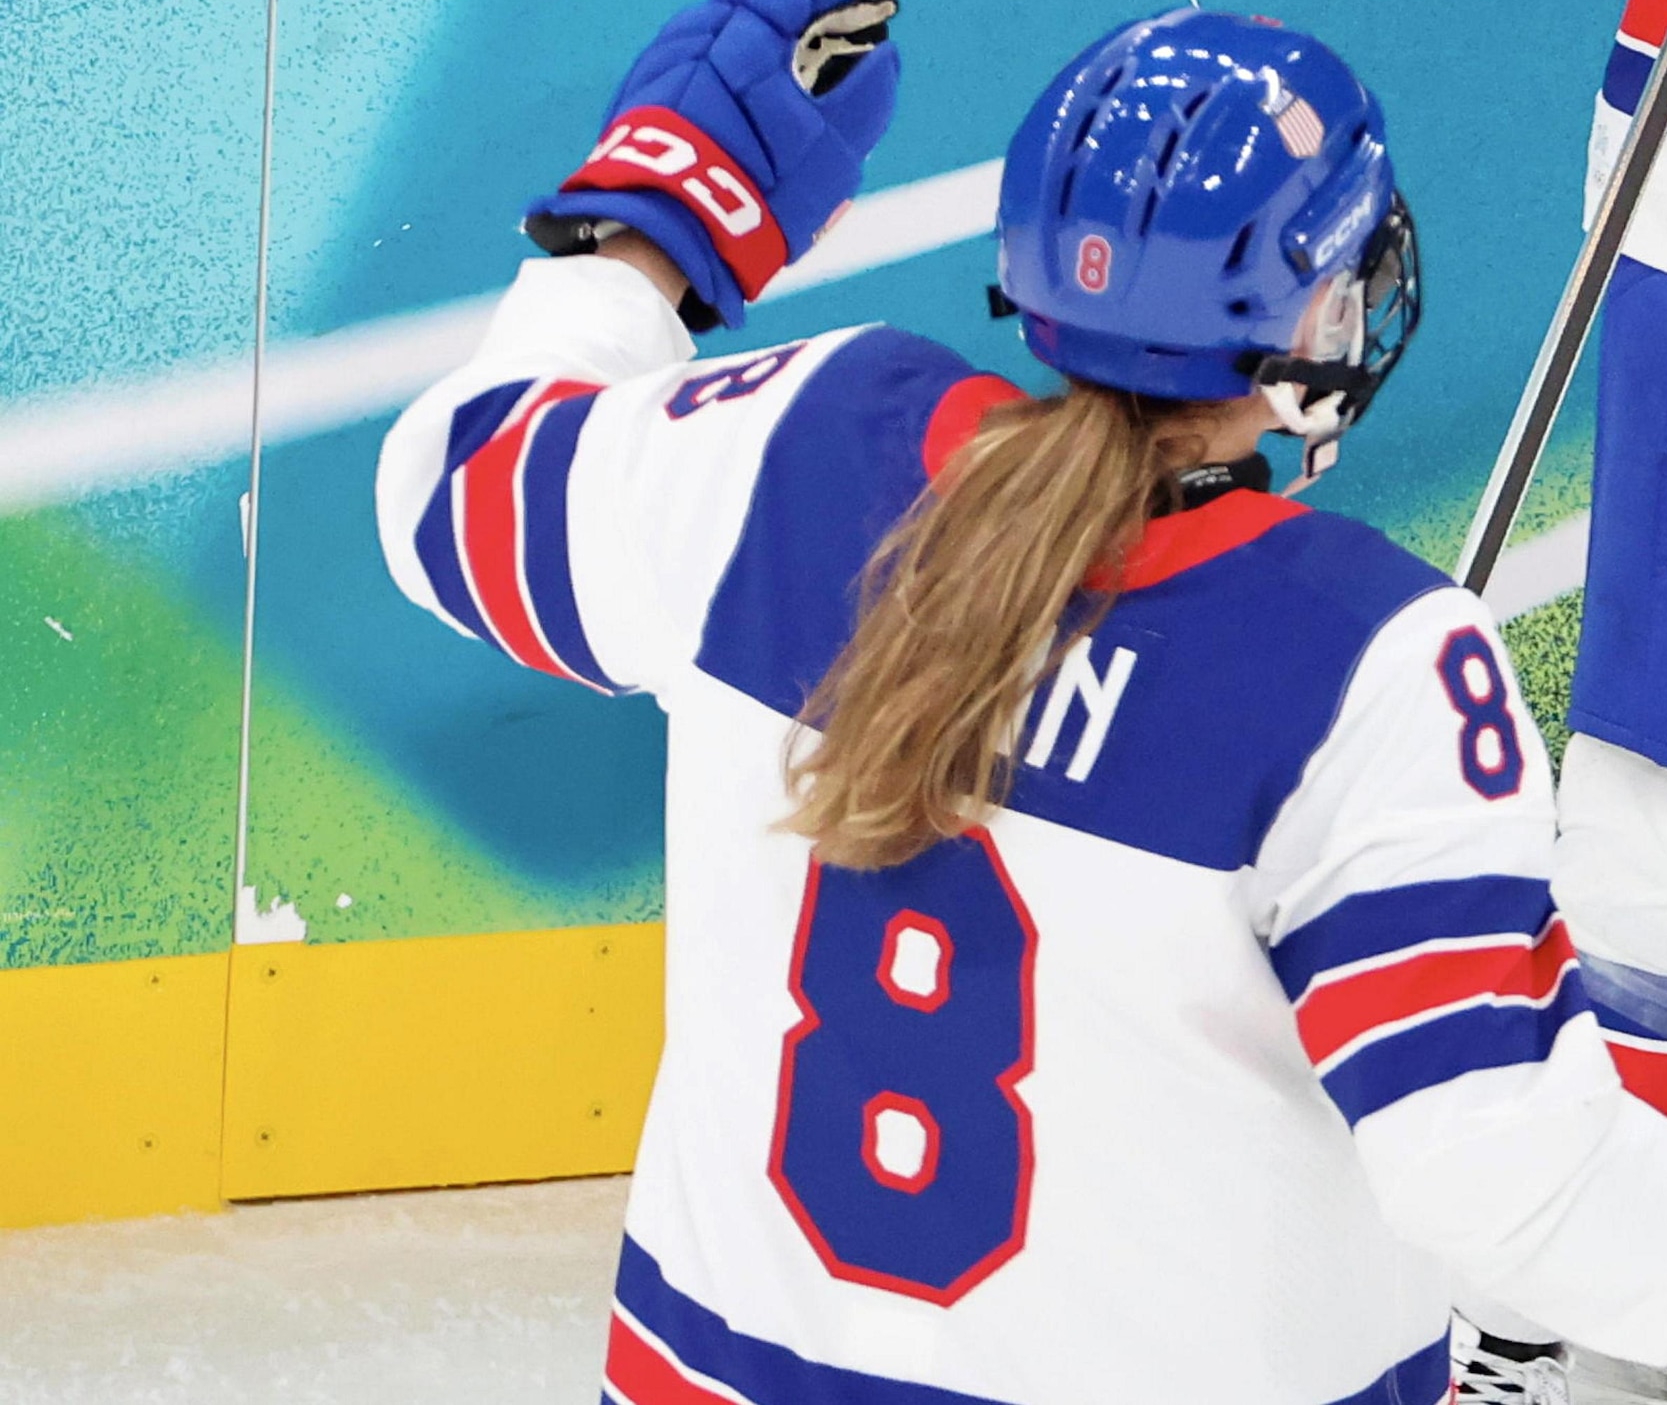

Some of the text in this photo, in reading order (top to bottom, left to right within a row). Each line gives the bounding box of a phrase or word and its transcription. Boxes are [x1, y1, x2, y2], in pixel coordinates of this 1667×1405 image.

[1074, 235, 1112, 293] 8
[1314, 192, 1373, 268] CCM
[664, 342, 808, 421] 8
[1435, 624, 1524, 800] 8
[767, 824, 1038, 1308] 8
